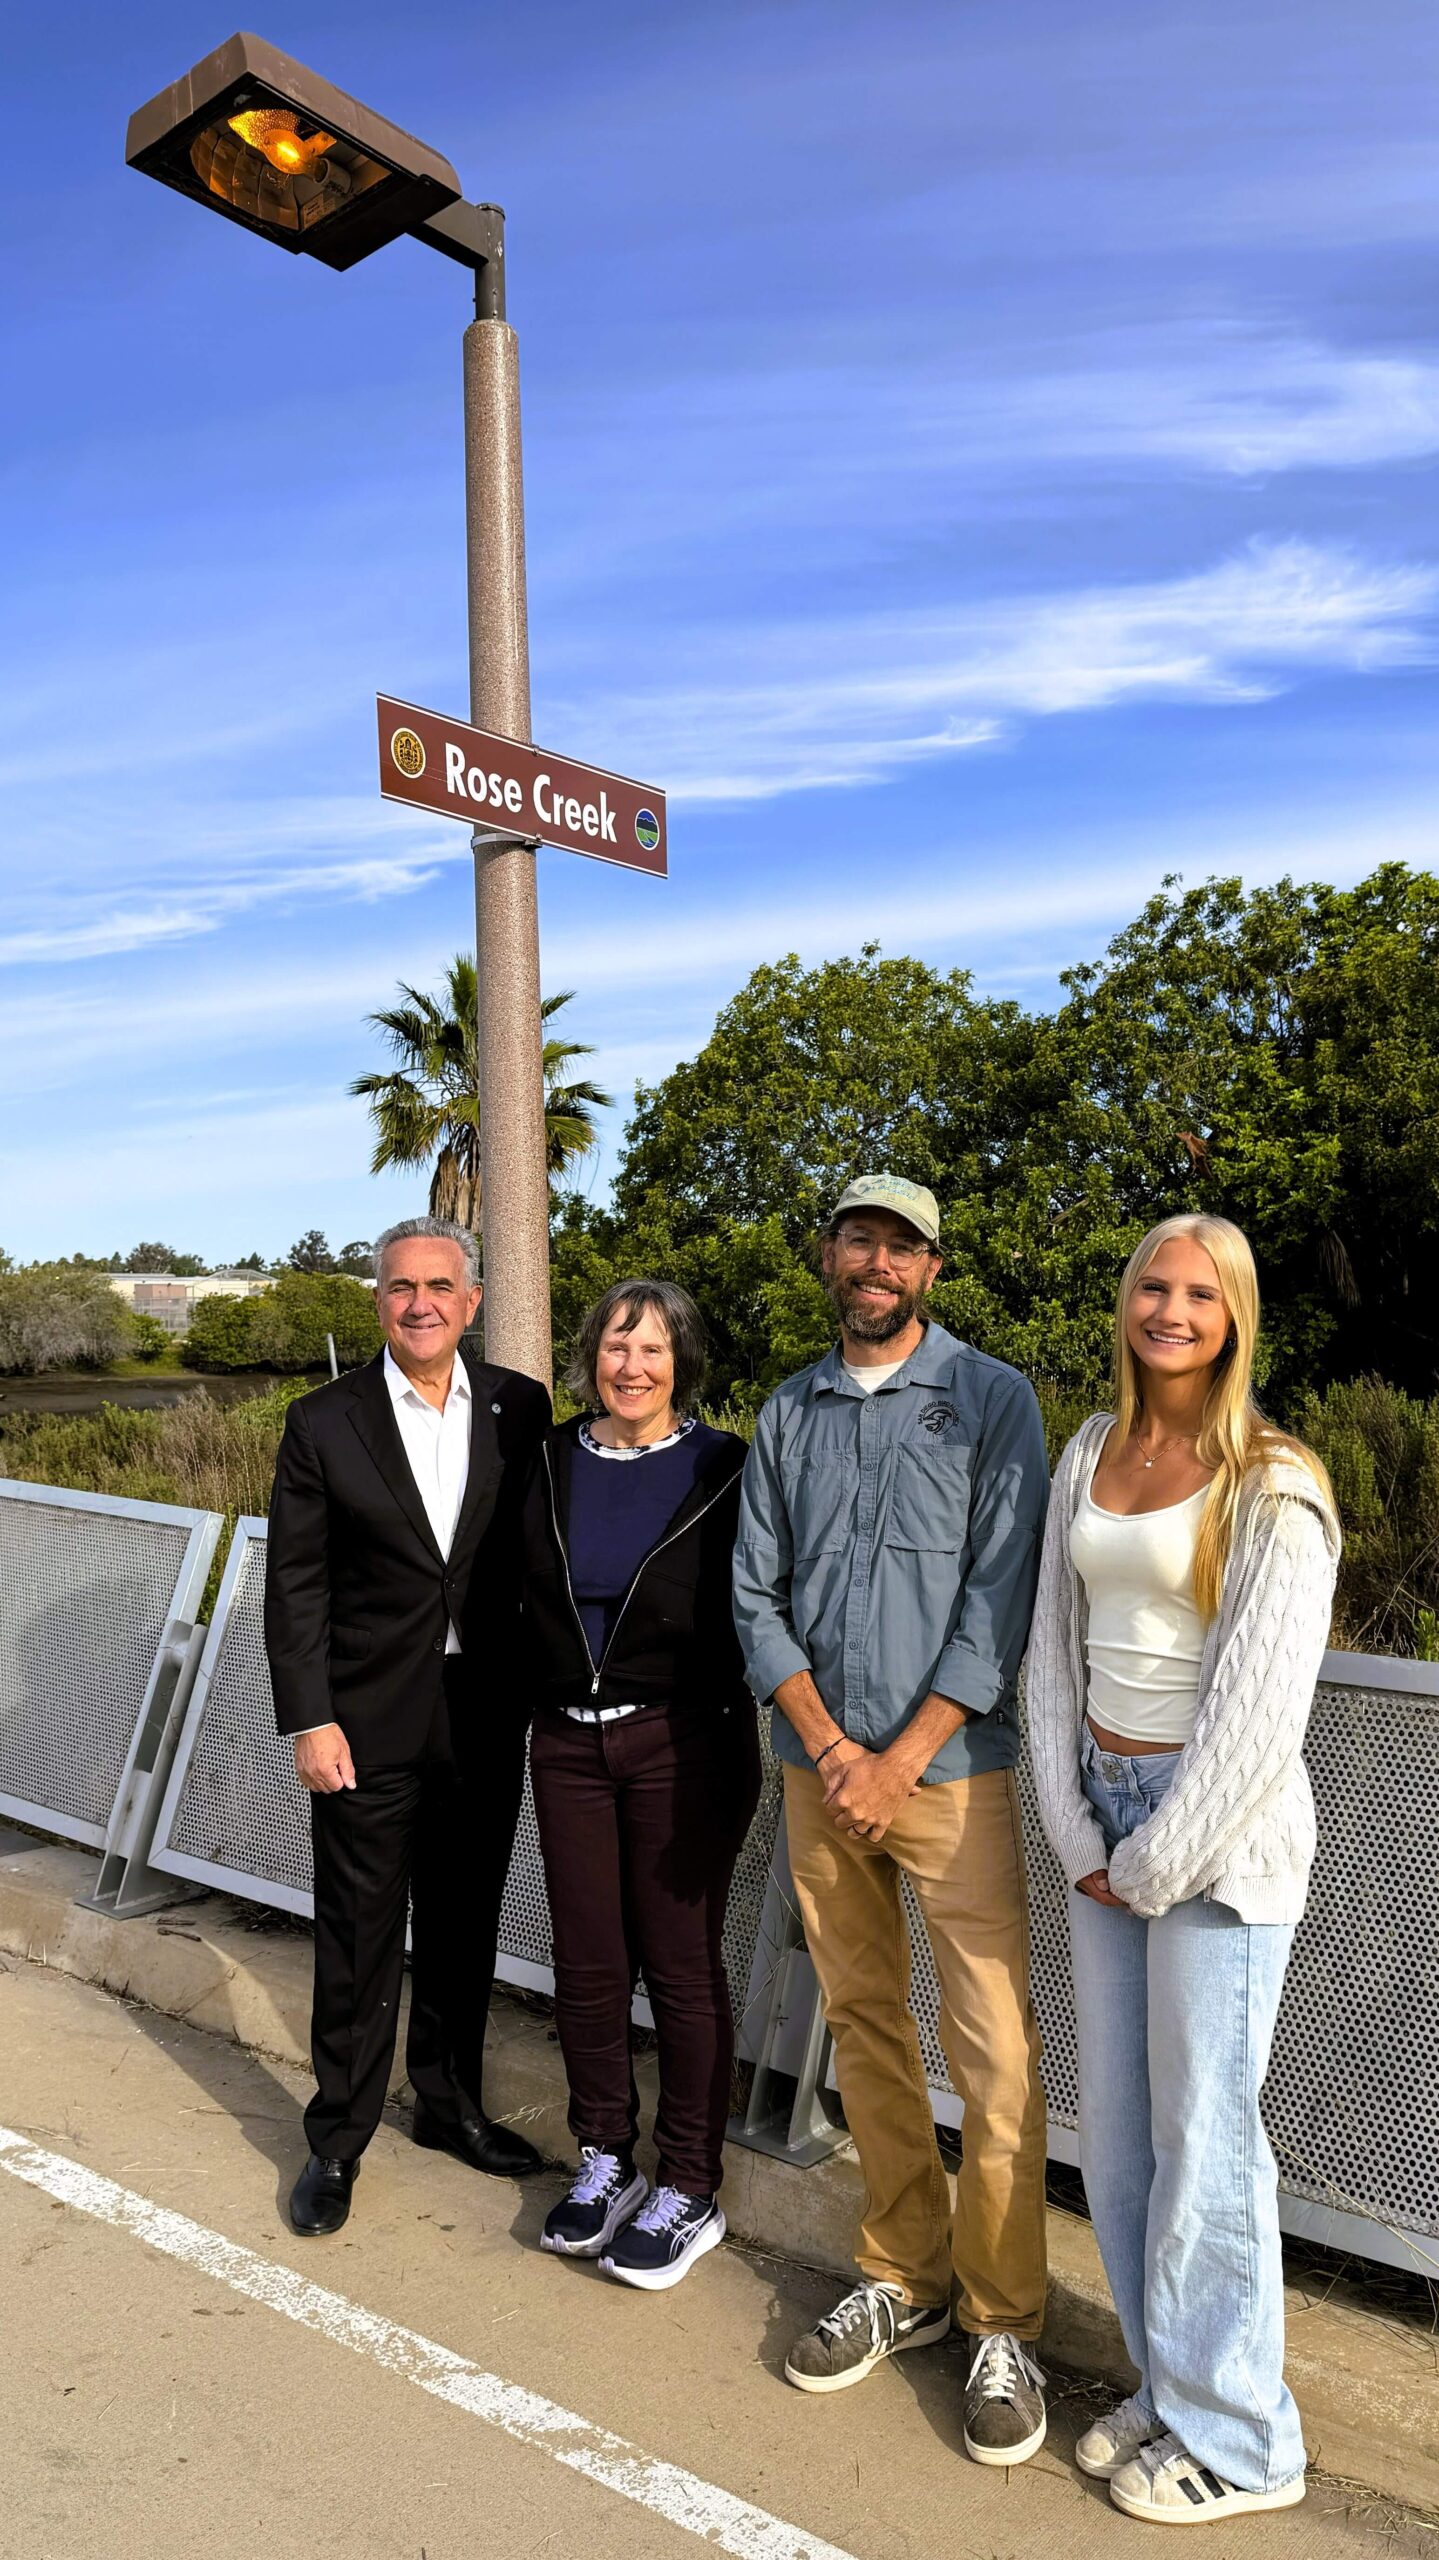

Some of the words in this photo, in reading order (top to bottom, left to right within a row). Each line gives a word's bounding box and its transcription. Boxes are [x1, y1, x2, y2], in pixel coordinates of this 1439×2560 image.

[445, 742, 523, 813] Rose
[533, 774, 618, 843] Creek
[920, 1401, 936, 1413] DIEGO
